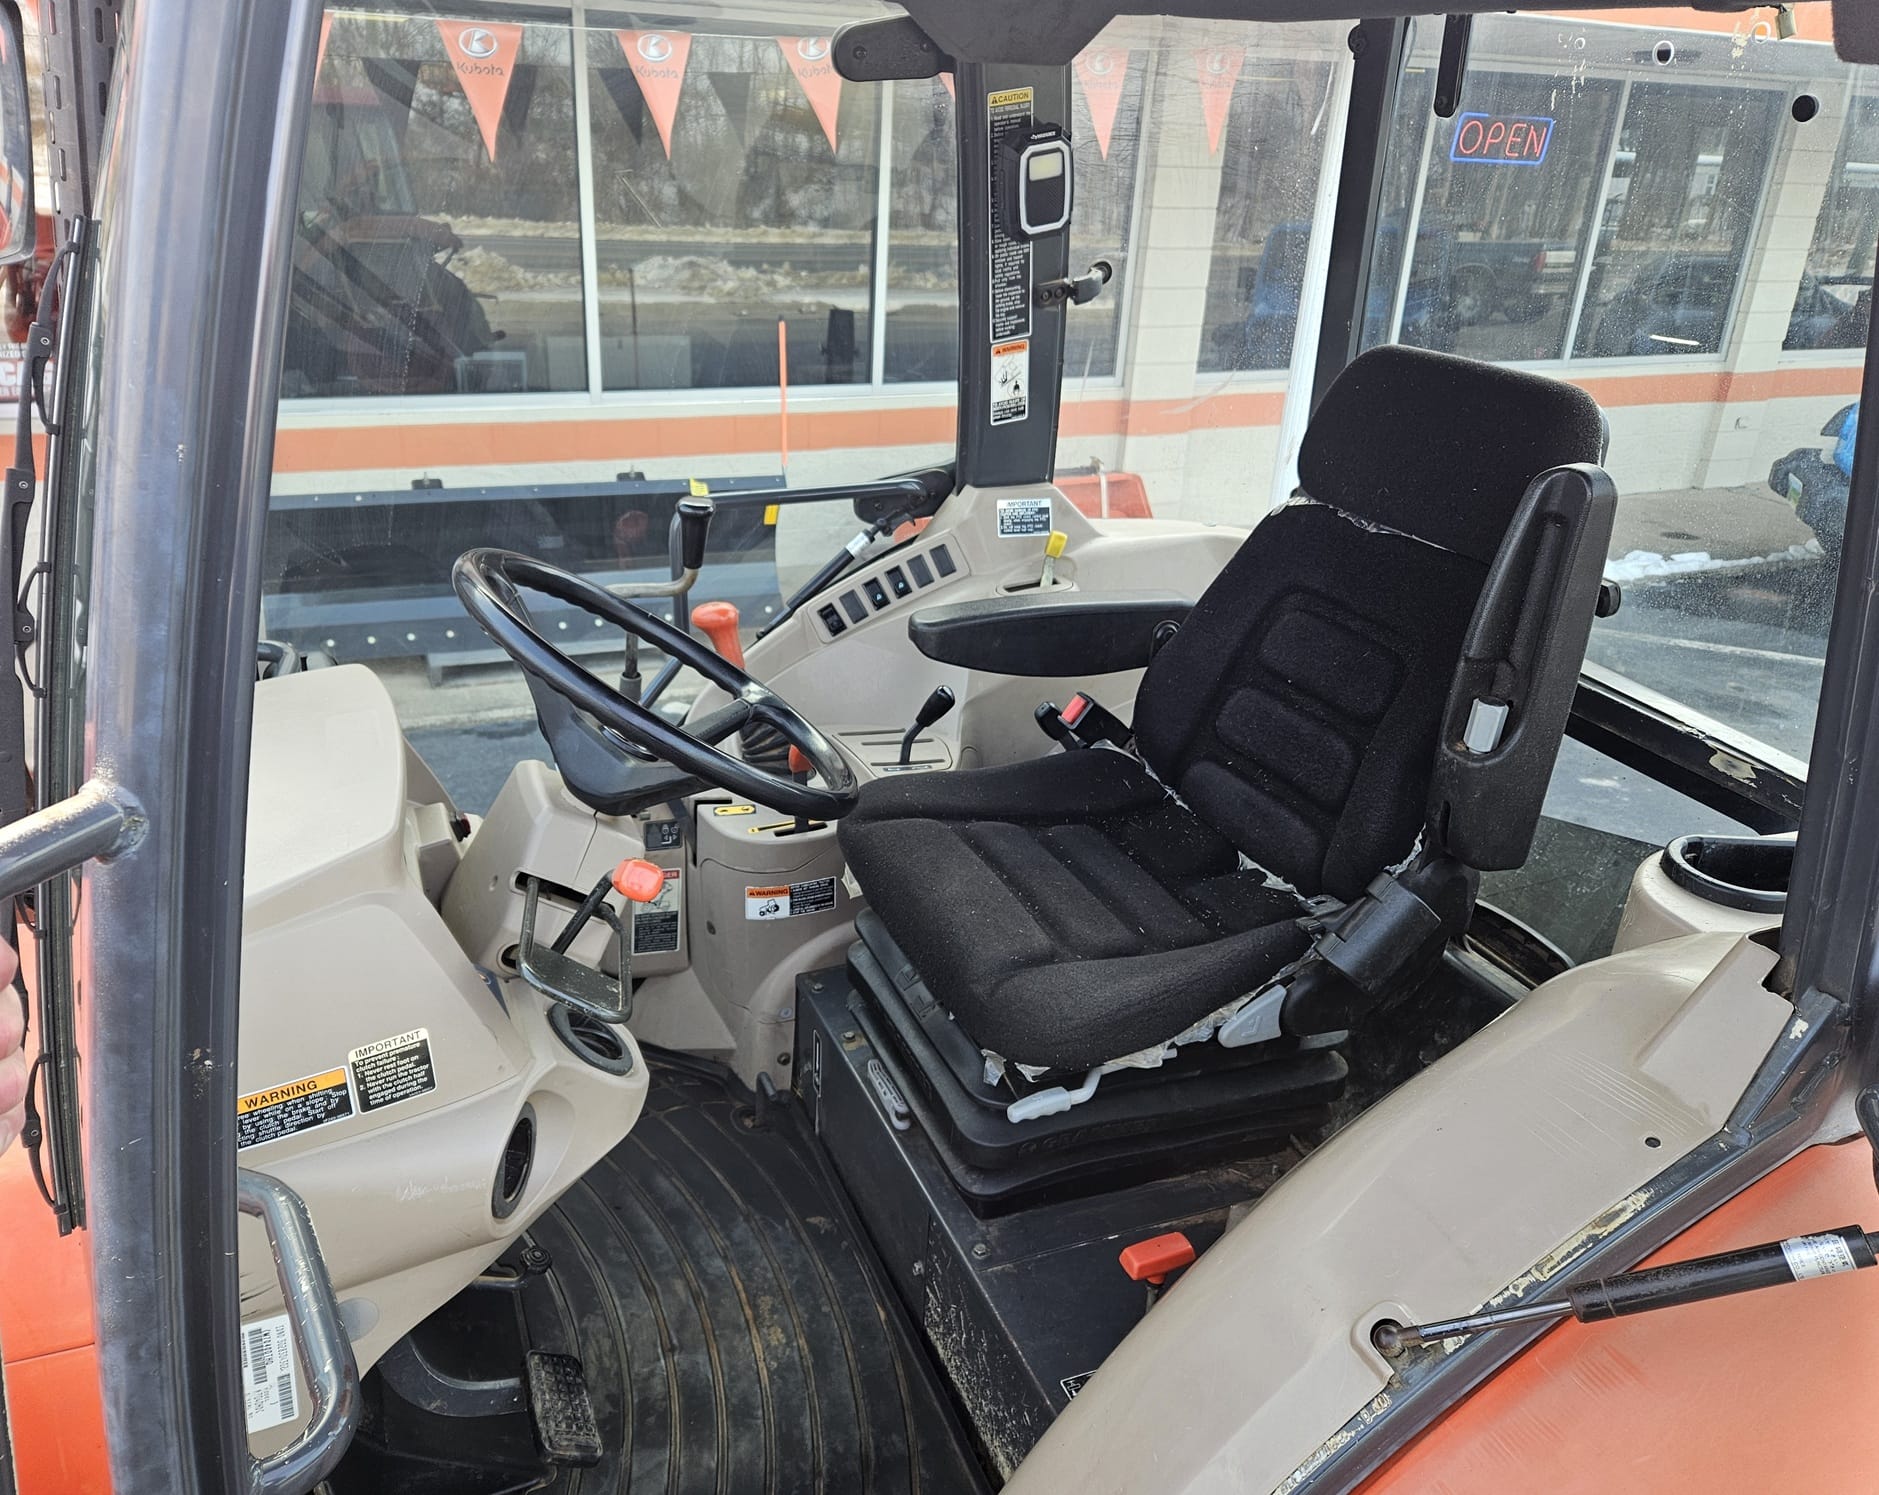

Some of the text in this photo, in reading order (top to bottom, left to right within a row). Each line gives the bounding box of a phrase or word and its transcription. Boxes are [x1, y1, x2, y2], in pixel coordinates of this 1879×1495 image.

[457, 62, 505, 77] Kubota
[635, 65, 679, 79] Kubota
[797, 63, 831, 78] Kubot
[998, 92, 1029, 103] CAUTION
[1459, 120, 1547, 157] OPEN
[355, 1031, 420, 1058] IMPORTANT
[356, 1062, 376, 1072] clutch
[365, 1052, 388, 1064] prevent
[365, 1067, 383, 1076] Never
[384, 1062, 396, 1070] rest
[397, 1058, 409, 1066] foot
[367, 1079, 385, 1088] Never
[386, 1074, 397, 1082] run
[409, 1064, 429, 1074] tractor
[368, 1086, 381, 1094] with
[394, 1076, 413, 1085] clutch
[413, 1070, 425, 1079] half
[377, 1069, 396, 1078] clutch
[245, 1080, 318, 1108] WARNING
[369, 1086, 396, 1099] engaged
[397, 1081, 417, 1090] during
[243, 1116, 260, 1124] lever
[263, 1110, 281, 1118] while
[332, 1090, 346, 1098] Stop
[253, 1104, 283, 1116] wheeling
[287, 1097, 304, 1106] when
[255, 1118, 273, 1127] using
[292, 1106, 310, 1115] brake
[315, 1101, 327, 1109] and
[258, 1126, 281, 1136] shuttle
[285, 1116, 313, 1128] direction
[260, 1121, 279, 1130] clutch
[308, 1107, 324, 1116] Start
[256, 1133, 275, 1142] clutch
